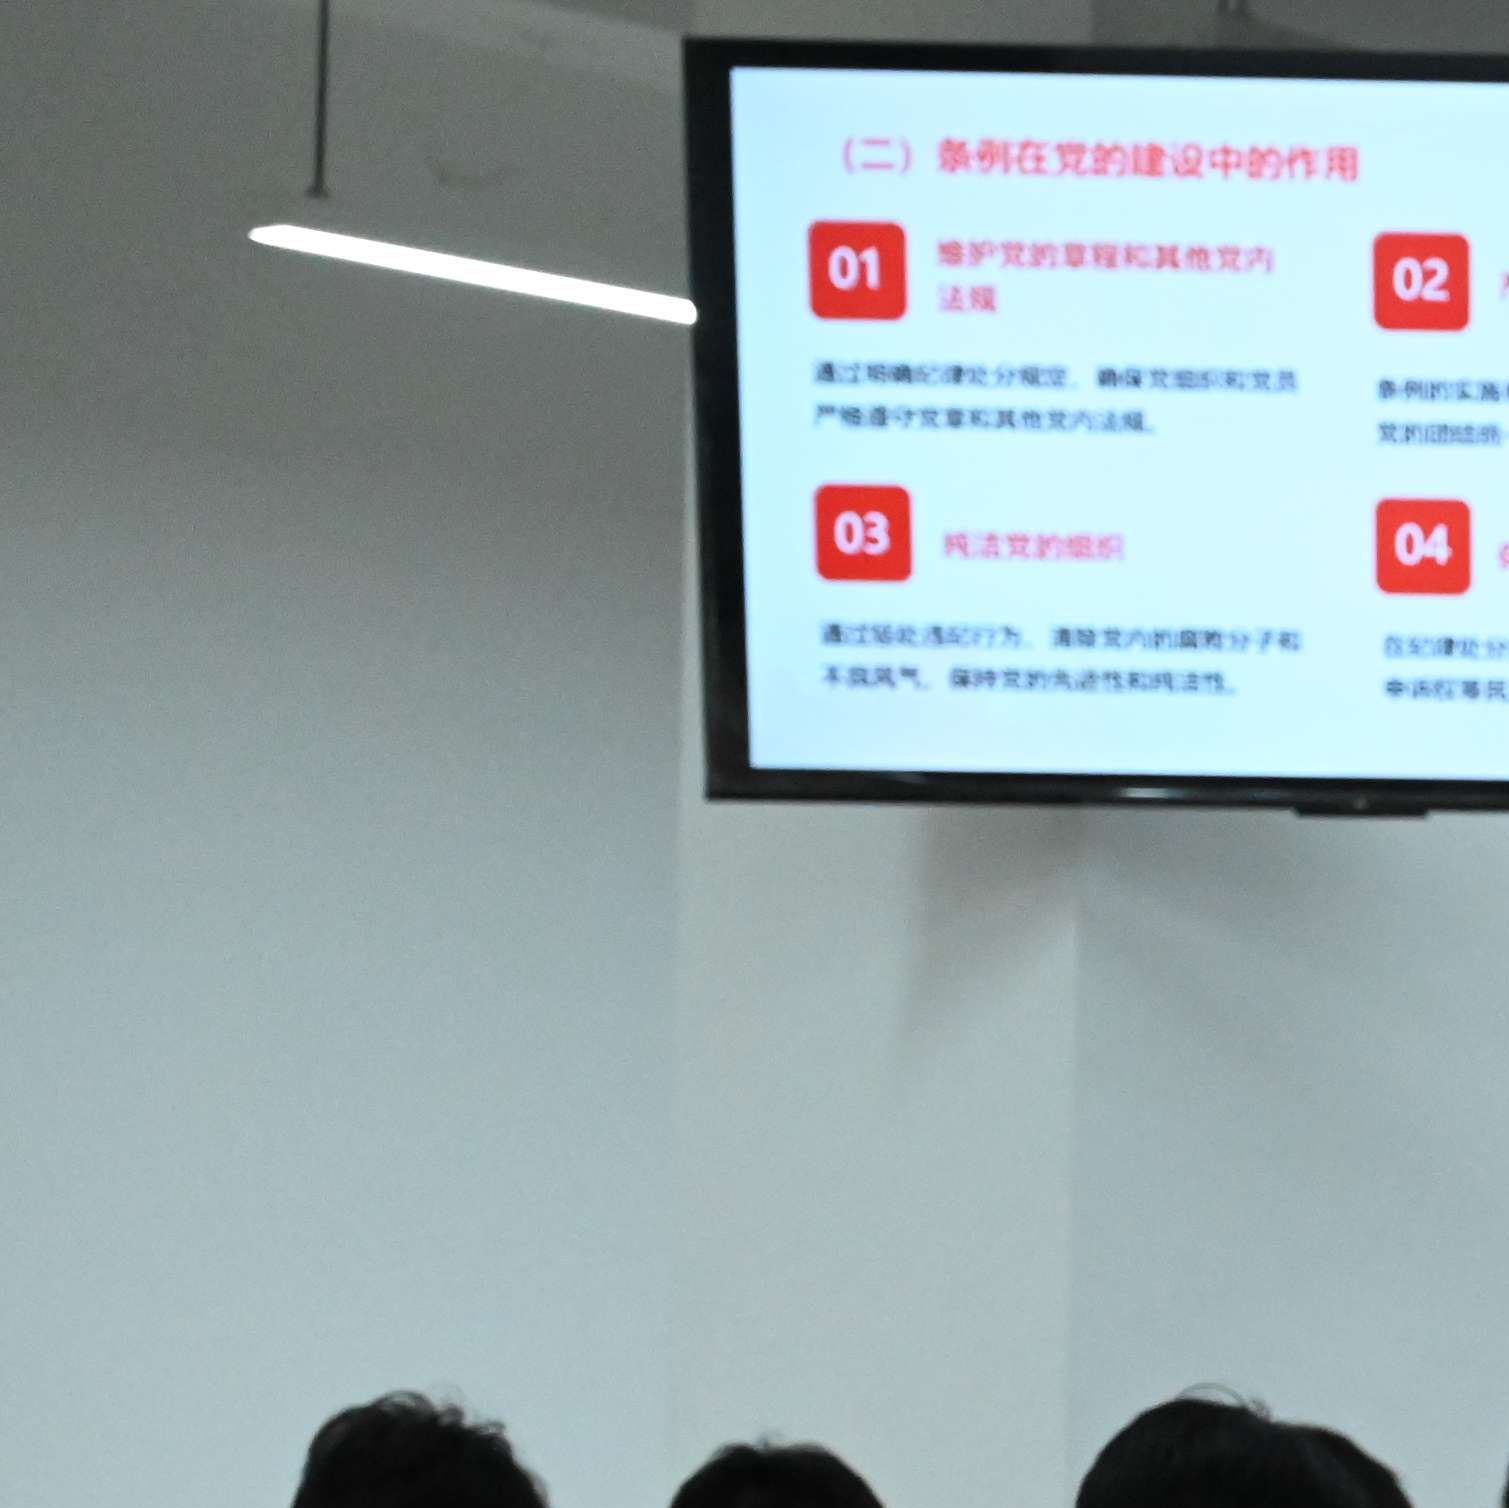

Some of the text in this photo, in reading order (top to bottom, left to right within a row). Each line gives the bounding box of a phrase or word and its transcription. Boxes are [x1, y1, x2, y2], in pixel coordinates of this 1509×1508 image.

[828, 245, 880, 290] 01
[1392, 256, 1450, 302] 02
[937, 284, 999, 315] 法规
[834, 511, 890, 555] 03
[943, 530, 1126, 562] 纯洁党的组织
[1394, 522, 1452, 566] 04
